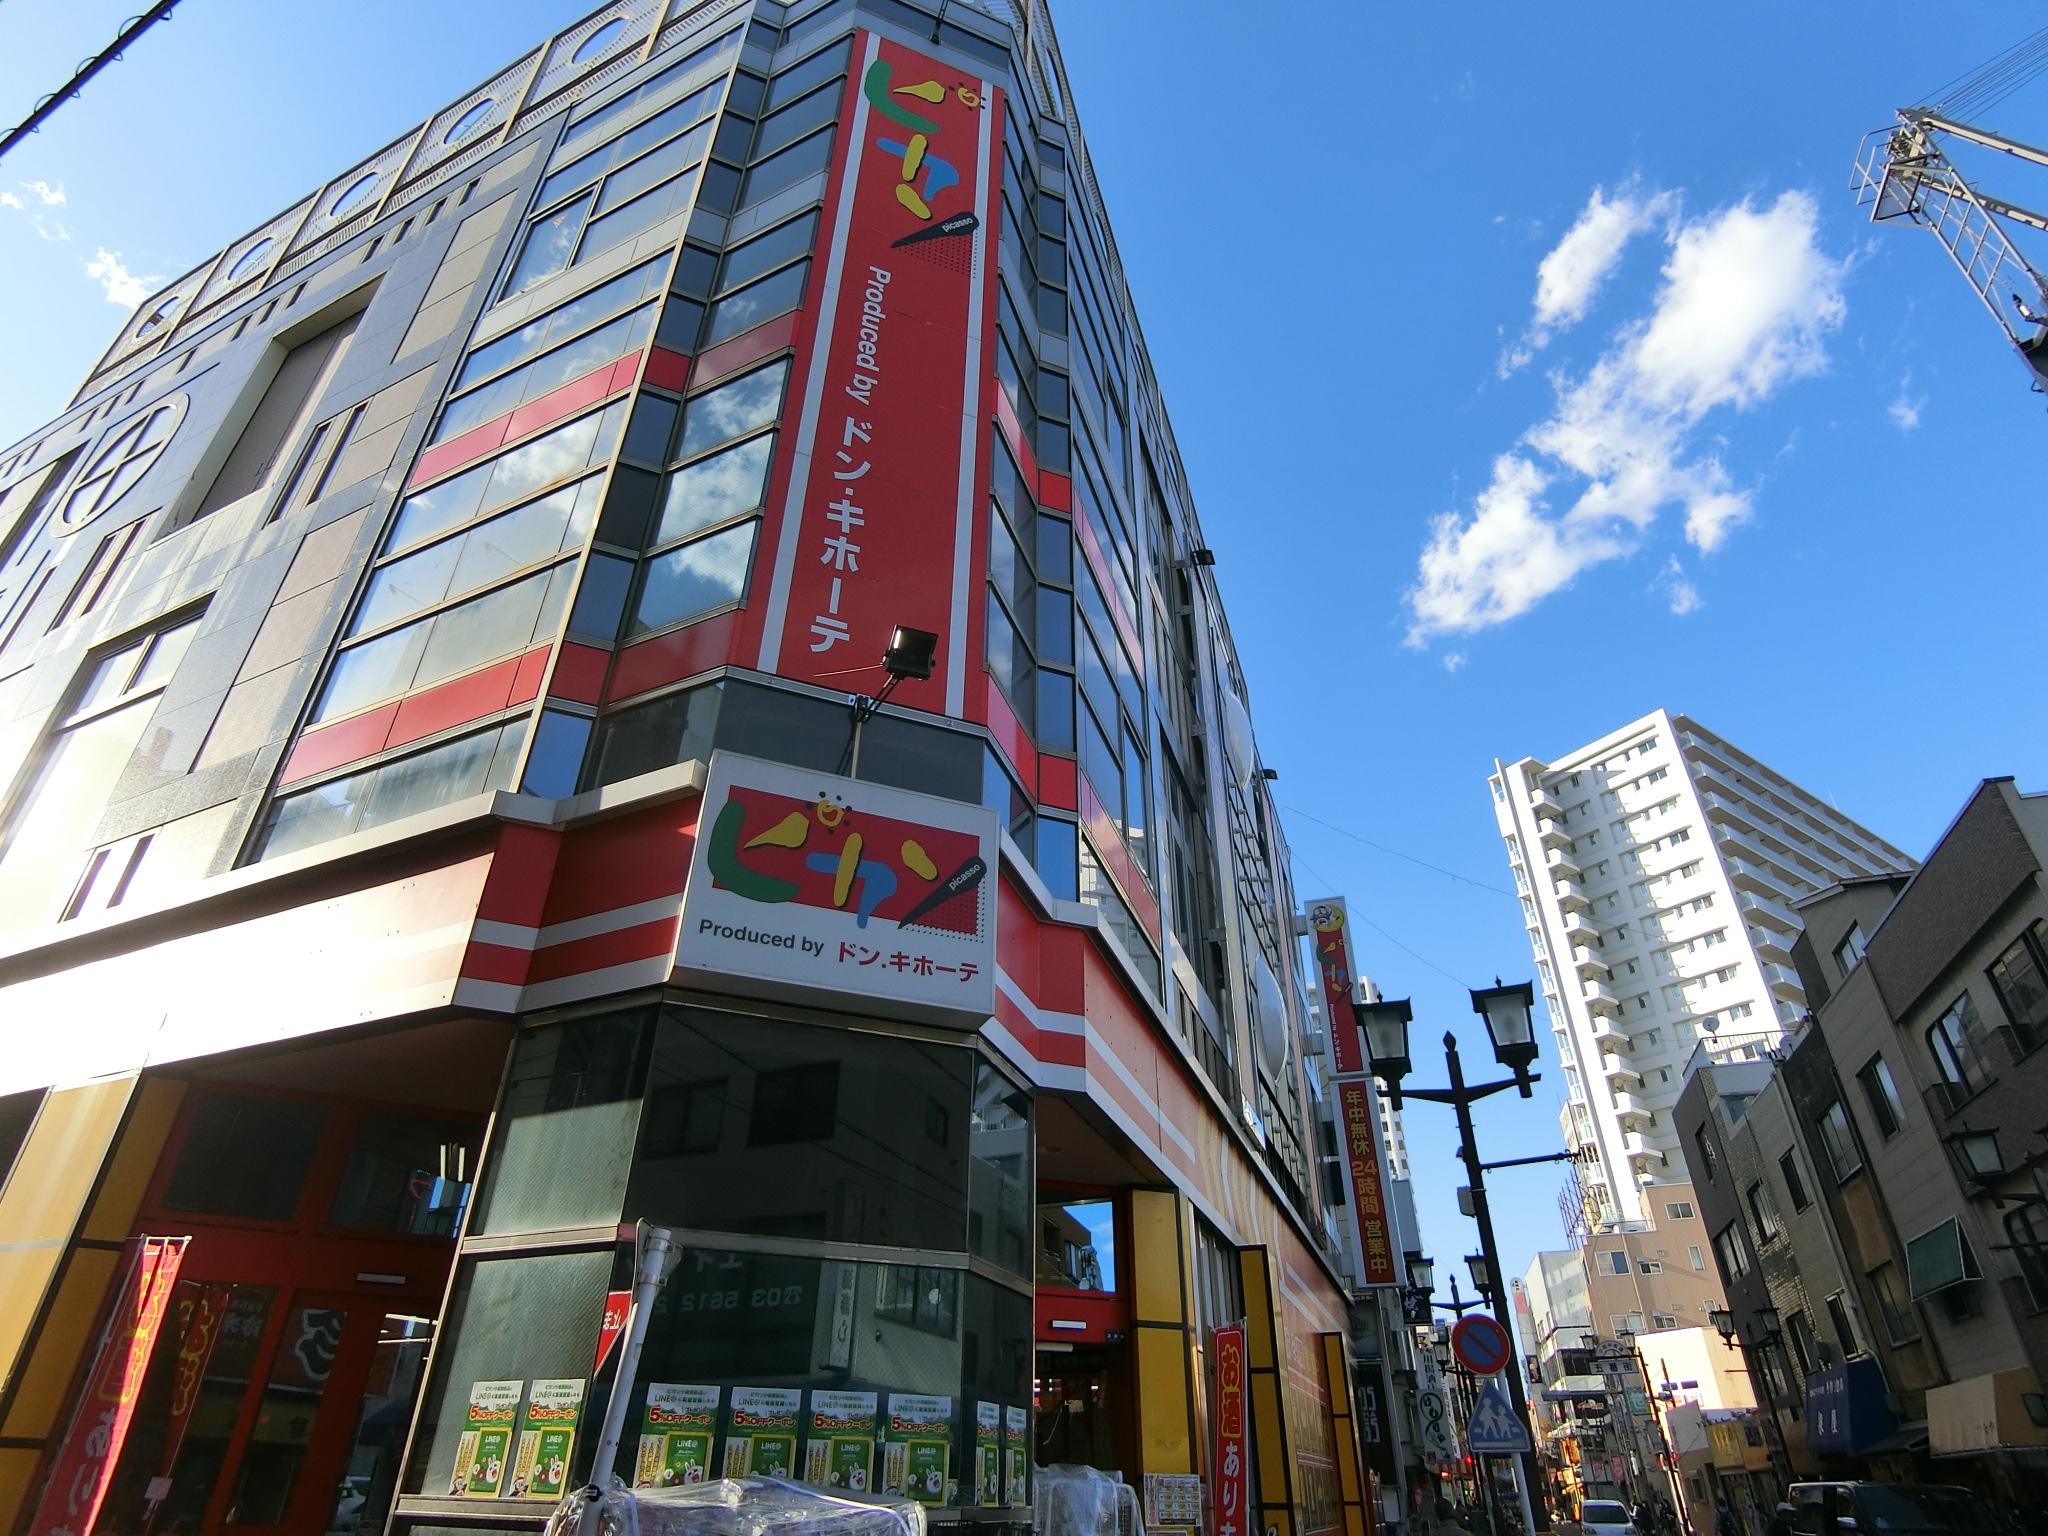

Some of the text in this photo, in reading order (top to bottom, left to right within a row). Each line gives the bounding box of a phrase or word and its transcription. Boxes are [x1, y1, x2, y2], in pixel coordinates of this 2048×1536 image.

[941, 216, 974, 233] picasso
[855, 264, 892, 372] Produced
[845, 377, 879, 406] by
[948, 862, 982, 891] picasso
[699, 918, 796, 950] Produced
[801, 936, 824, 957] by
[1345, 1089, 1388, 1275] 年中無休 24時間 営業中
